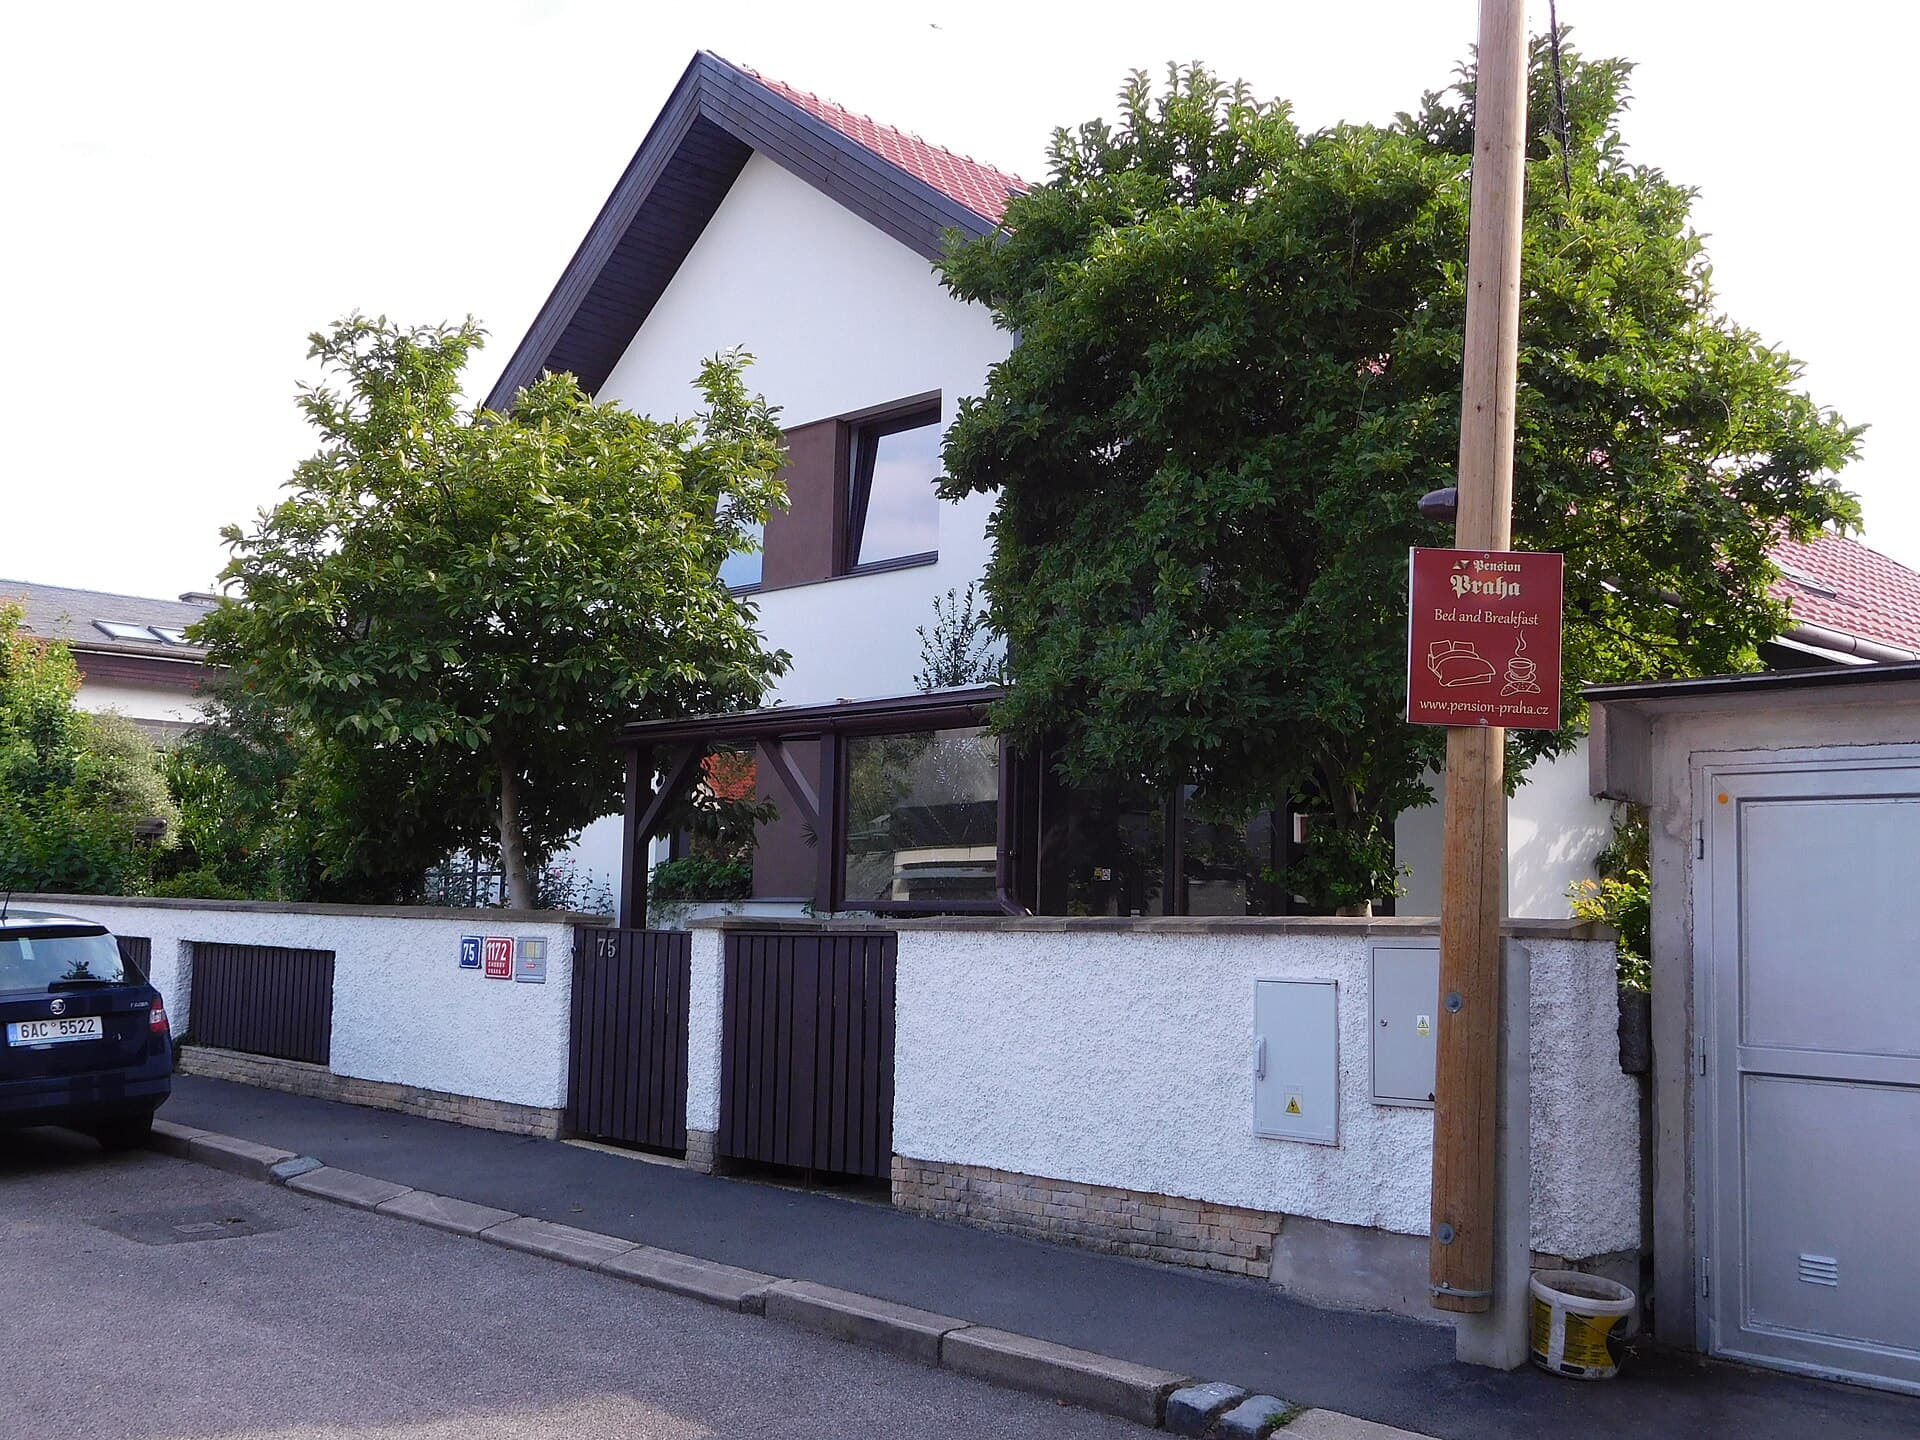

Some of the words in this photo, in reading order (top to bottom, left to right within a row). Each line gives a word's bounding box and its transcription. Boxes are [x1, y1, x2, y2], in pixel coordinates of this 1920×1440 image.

[1473, 559, 1521, 573] Pension
[1450, 574, 1521, 601] Praha
[1434, 608, 1456, 622] Bed
[1458, 609, 1482, 623] and
[1485, 610, 1539, 629] Breakfast
[1419, 700, 1549, 717] www.pension-praha.cz
[463, 943, 475, 961] 75
[487, 942, 507, 961] 1172
[597, 938, 616, 958] 75
[20, 1022, 49, 1039] 6AC
[59, 1018, 96, 1035] 5522
